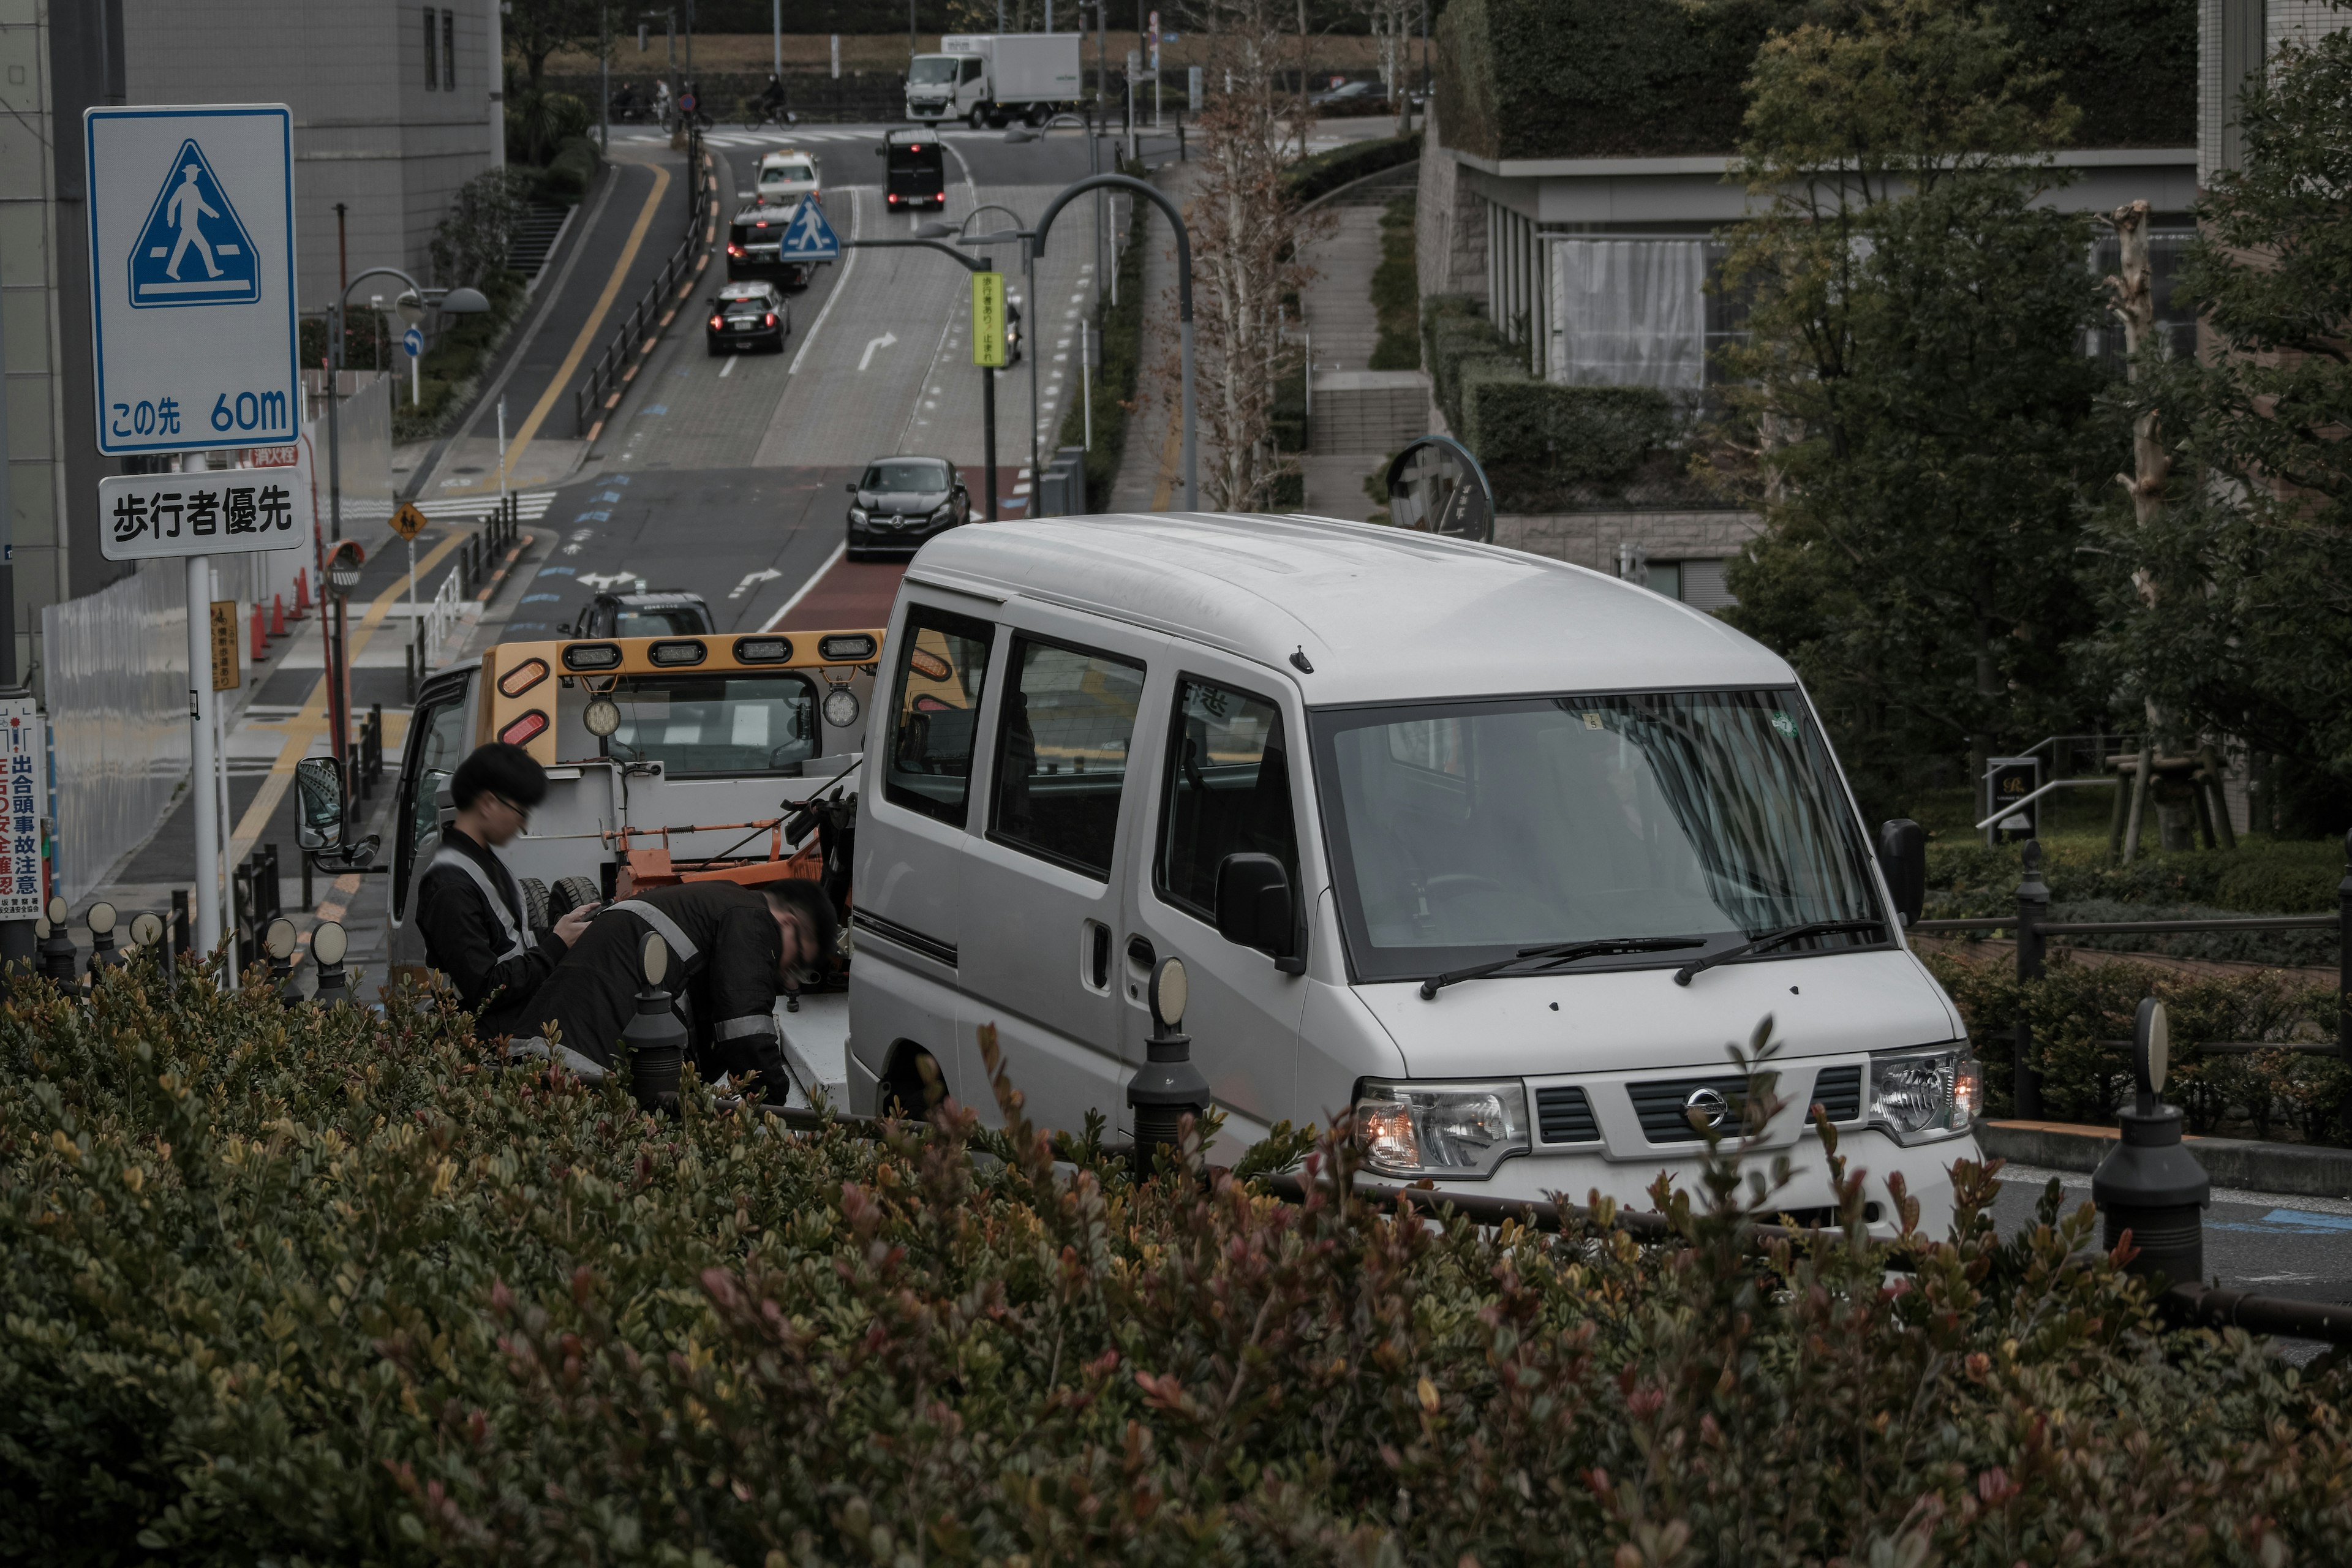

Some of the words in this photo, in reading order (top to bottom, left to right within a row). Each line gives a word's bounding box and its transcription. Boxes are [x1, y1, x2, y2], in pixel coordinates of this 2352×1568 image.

[113, 397, 180, 437] この先
[211, 390, 287, 431] 60m
[113, 484, 292, 542] 歩行者優先
[217, 627, 229, 686] 横断歩道あり
[1782, 721, 1787, 729] 7
[11, 755, 37, 894] 出合頭事故注意
